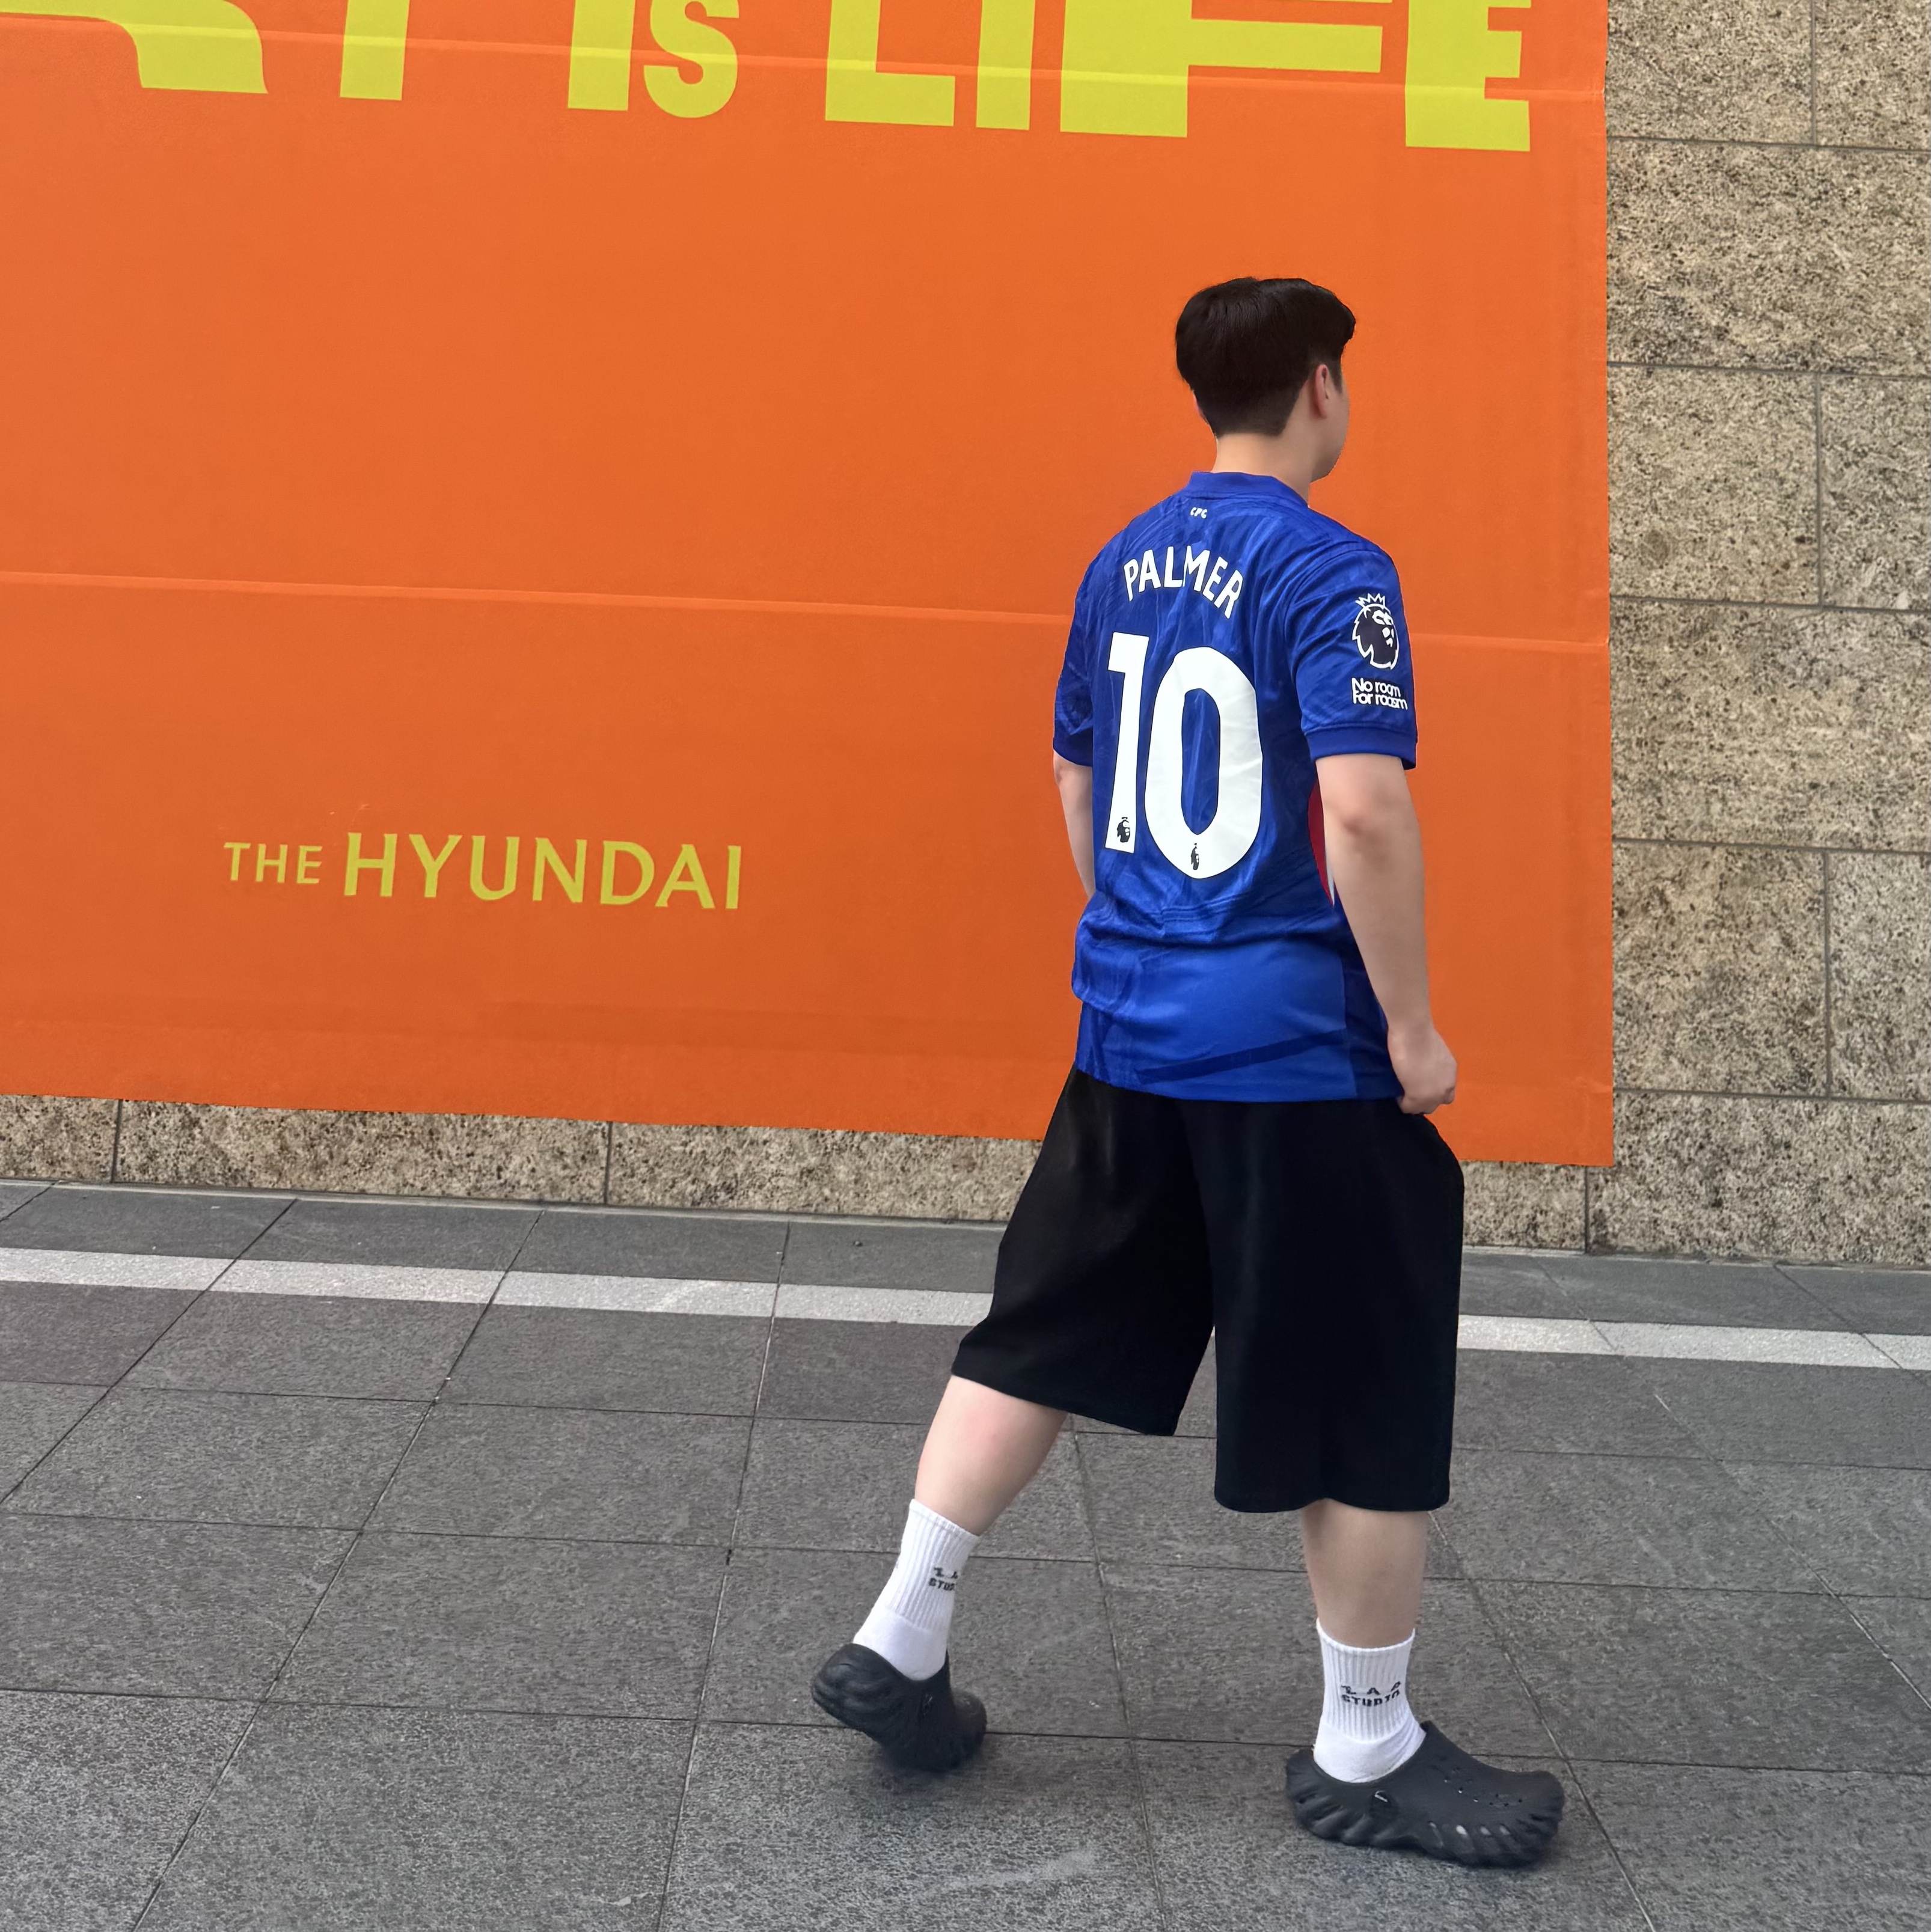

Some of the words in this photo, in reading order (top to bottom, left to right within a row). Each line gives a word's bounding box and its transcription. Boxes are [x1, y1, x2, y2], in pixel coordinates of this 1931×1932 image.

[1124, 545, 1243, 619] PALMER
[1351, 677, 1373, 692] No
[1374, 682, 1401, 697] room
[1105, 632, 1263, 879] 10
[224, 842, 323, 884] THE
[344, 832, 742, 909] HYUNDAI
